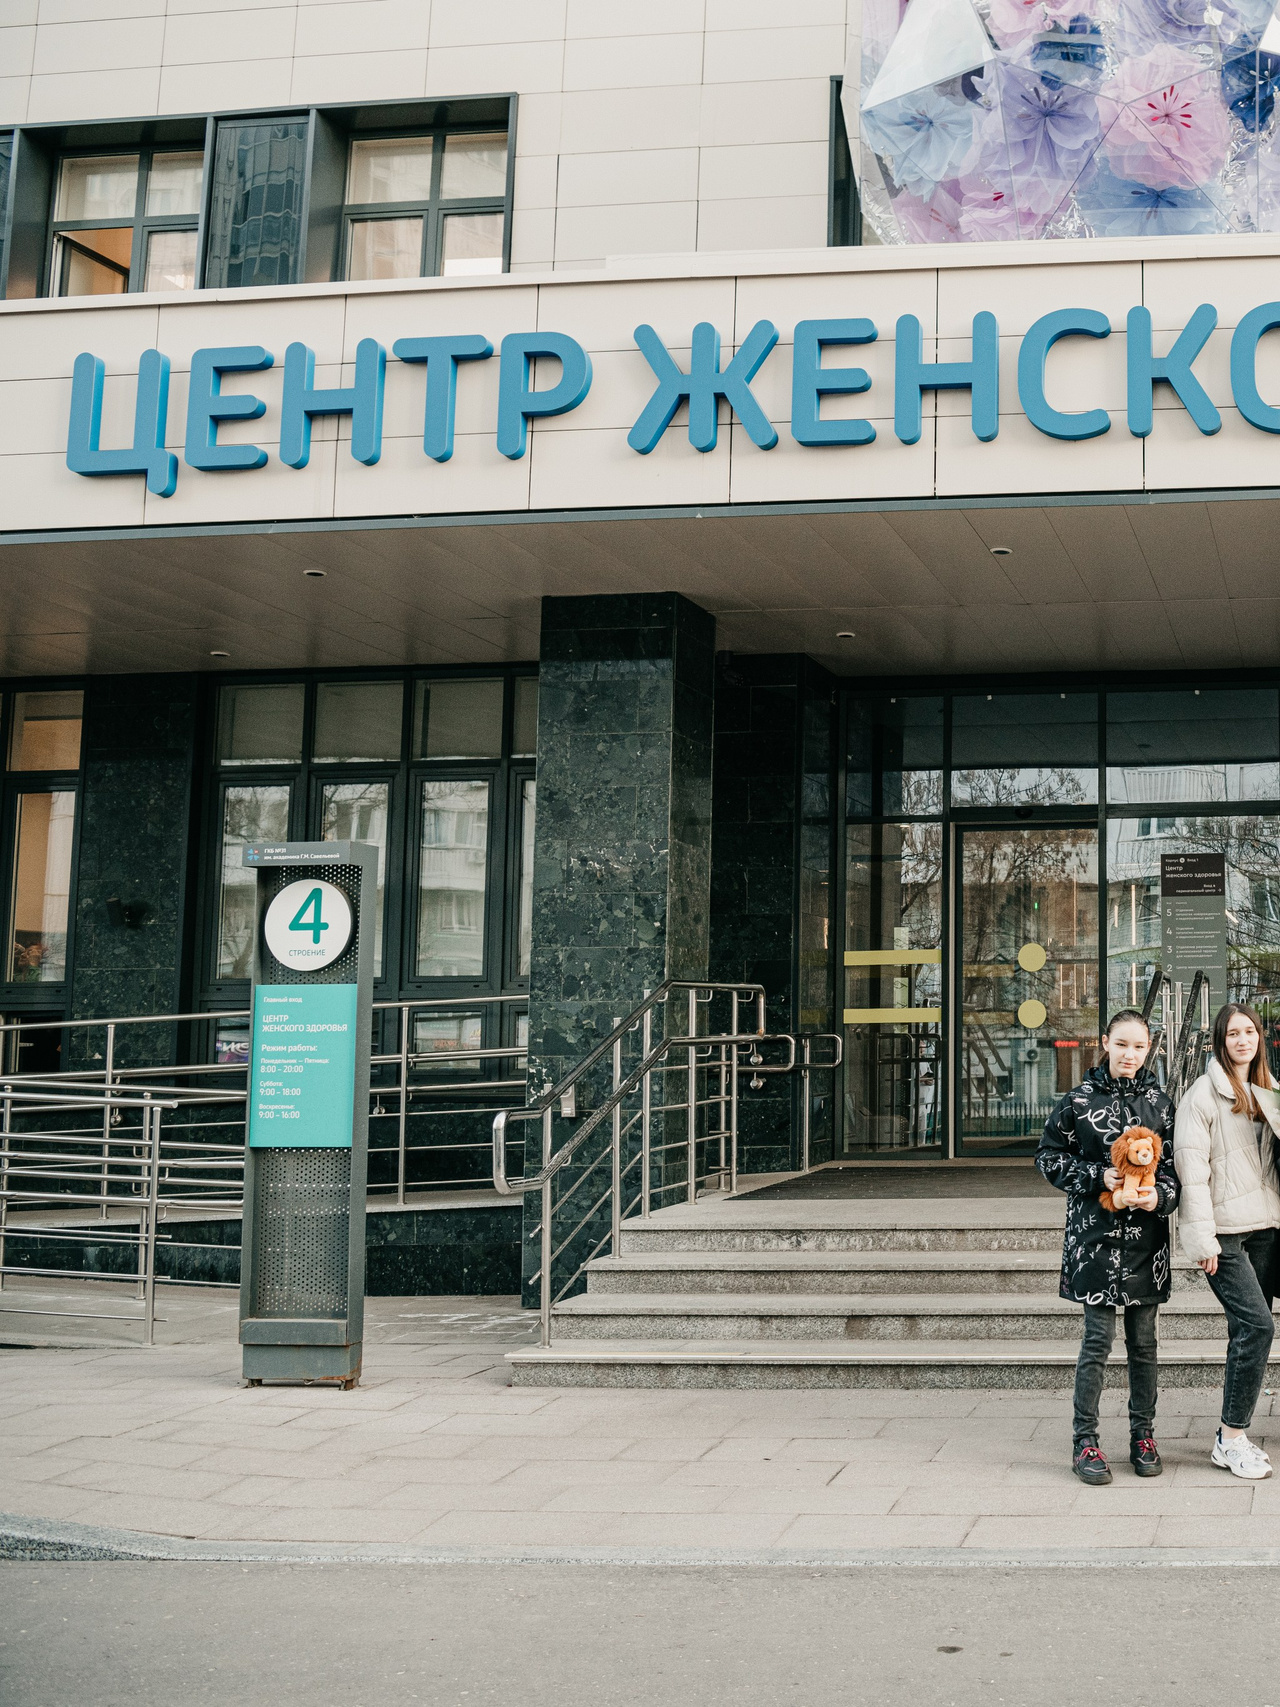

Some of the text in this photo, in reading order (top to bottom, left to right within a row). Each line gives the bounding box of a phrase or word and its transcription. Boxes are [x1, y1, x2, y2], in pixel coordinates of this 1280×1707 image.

[67, 332, 592, 497] ЦЕНТР
[288, 888, 329, 944] 4
[1167, 945, 1172, 953] 3
[1167, 964, 1172, 972] 2
[262, 1015, 288, 1023] ЦЕНТР
[306, 1024, 347, 1032] ЗДОРОВЬЯ
[288, 1044, 318, 1053] работы:
